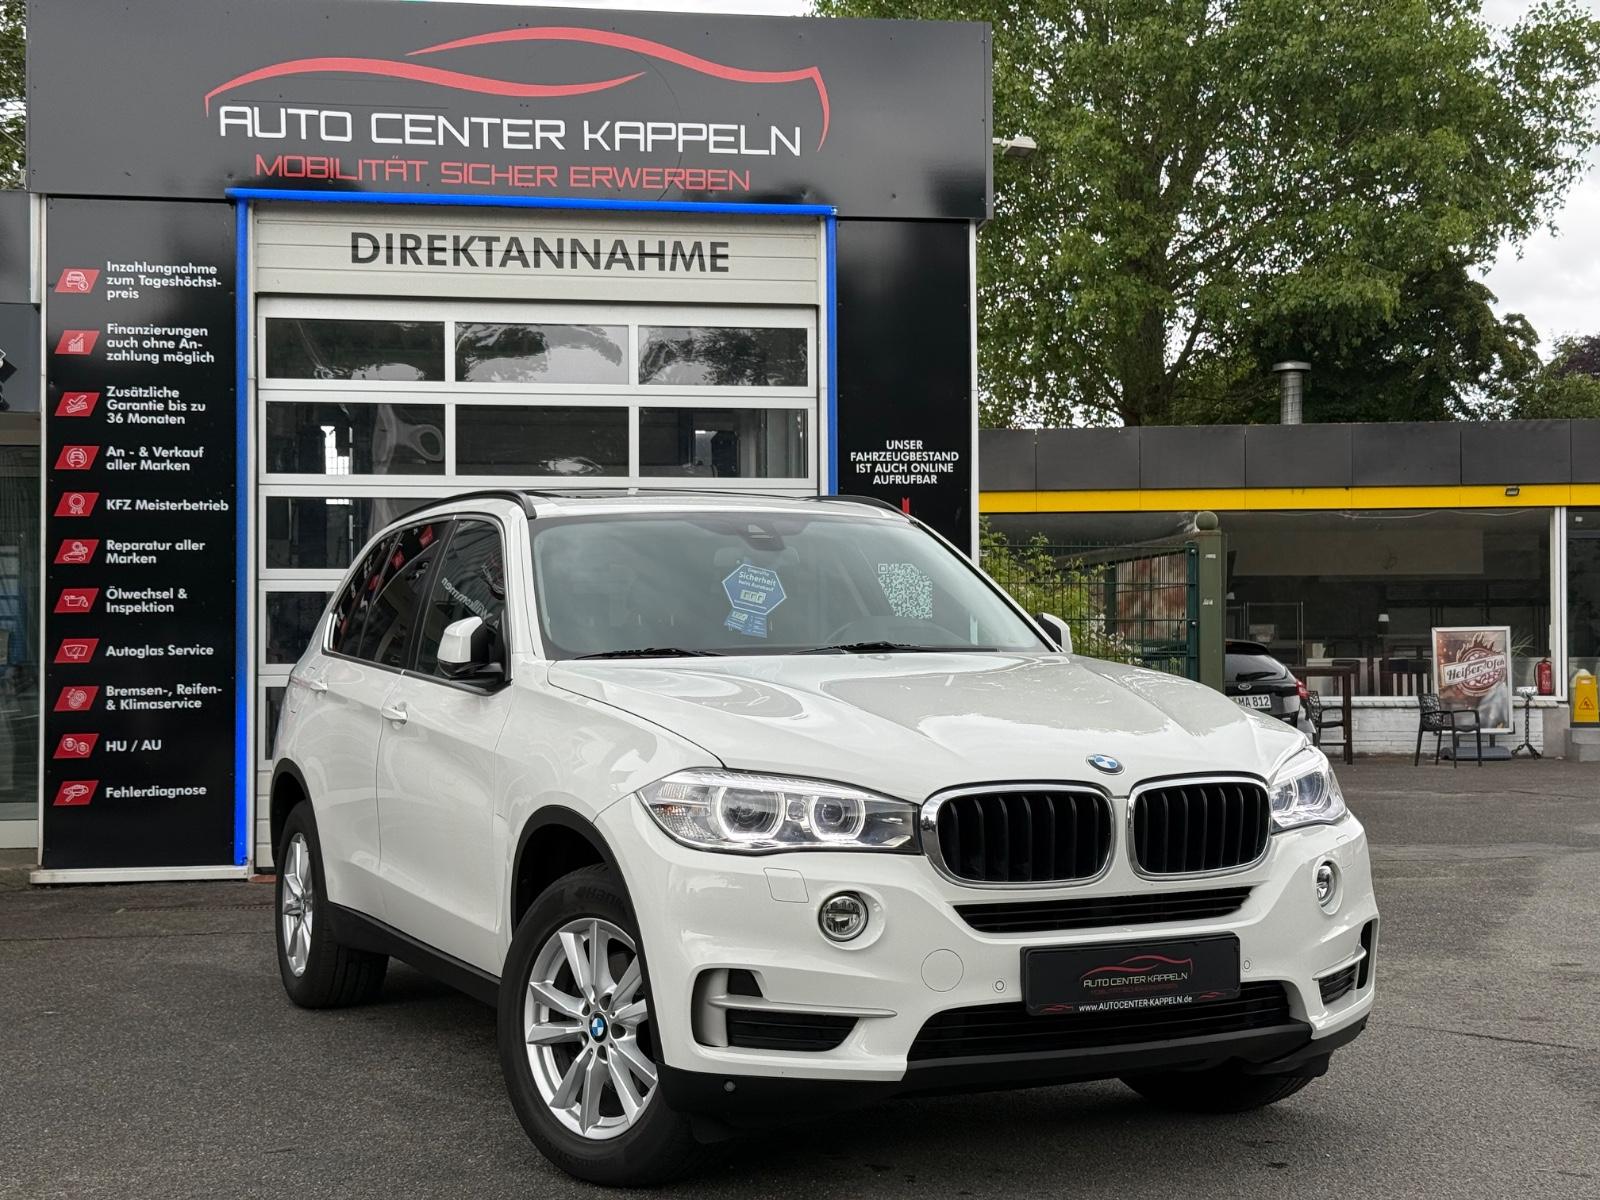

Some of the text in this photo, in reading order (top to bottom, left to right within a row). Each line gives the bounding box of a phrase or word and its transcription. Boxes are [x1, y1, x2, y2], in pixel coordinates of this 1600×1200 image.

[220, 106, 800, 156] AUTO CENTER KAPPELN
[255, 154, 750, 191] MOBILITÄT SICHER ERWERBEN
[351, 229, 728, 272] DIREKTANNAHME
[106, 260, 218, 276] Inzahlungnahme
[106, 274, 222, 288] zum Tageshöchst-
[107, 288, 139, 300] preis
[106, 323, 208, 338] Finanzierungen
[107, 337, 202, 349] auch ohne An-
[107, 350, 214, 364] zahlung möglich
[106, 386, 180, 399] Zusätzliche
[107, 399, 164, 410] Garantie
[169, 400, 187, 411] bis
[107, 413, 185, 424] 36 Monaten
[887, 440, 923, 449] UNSER
[106, 446, 124, 456] An
[139, 447, 148, 457] &
[152, 447, 204, 457] Verkauf
[851, 452, 959, 461] FAHRZEUGBESTAND
[106, 459, 190, 470] aller Marken
[856, 463, 953, 473] IST AUCH ONLINE
[873, 475, 937, 484] AUFRUFBAR
[107, 499, 228, 510] KFZ Meisterbetrieb
[106, 540, 205, 552] Reparatur aller
[106, 552, 156, 563] Marken
[738, 571, 777, 587] Sicherheit
[106, 586, 187, 599] Ölwechsel &
[107, 601, 174, 615] Inspektion
[106, 644, 213, 658] Autoglas Service
[1446, 664, 1483, 680] Heißer
[106, 683, 222, 698] Bremsen-, Reifen-
[106, 697, 202, 710] & Klimaservice
[1253, 696, 1270, 707] 812
[106, 741, 127, 751] HU
[141, 740, 161, 750] AU
[106, 785, 207, 800] Fehlerdiagnose
[1083, 978, 1110, 988] AUTO
[1110, 975, 1147, 986] CENTER
[1147, 972, 1188, 983] KAPPELN
[1078, 995, 1193, 1012] www.AUTOCENTER-KAPPELN.de
